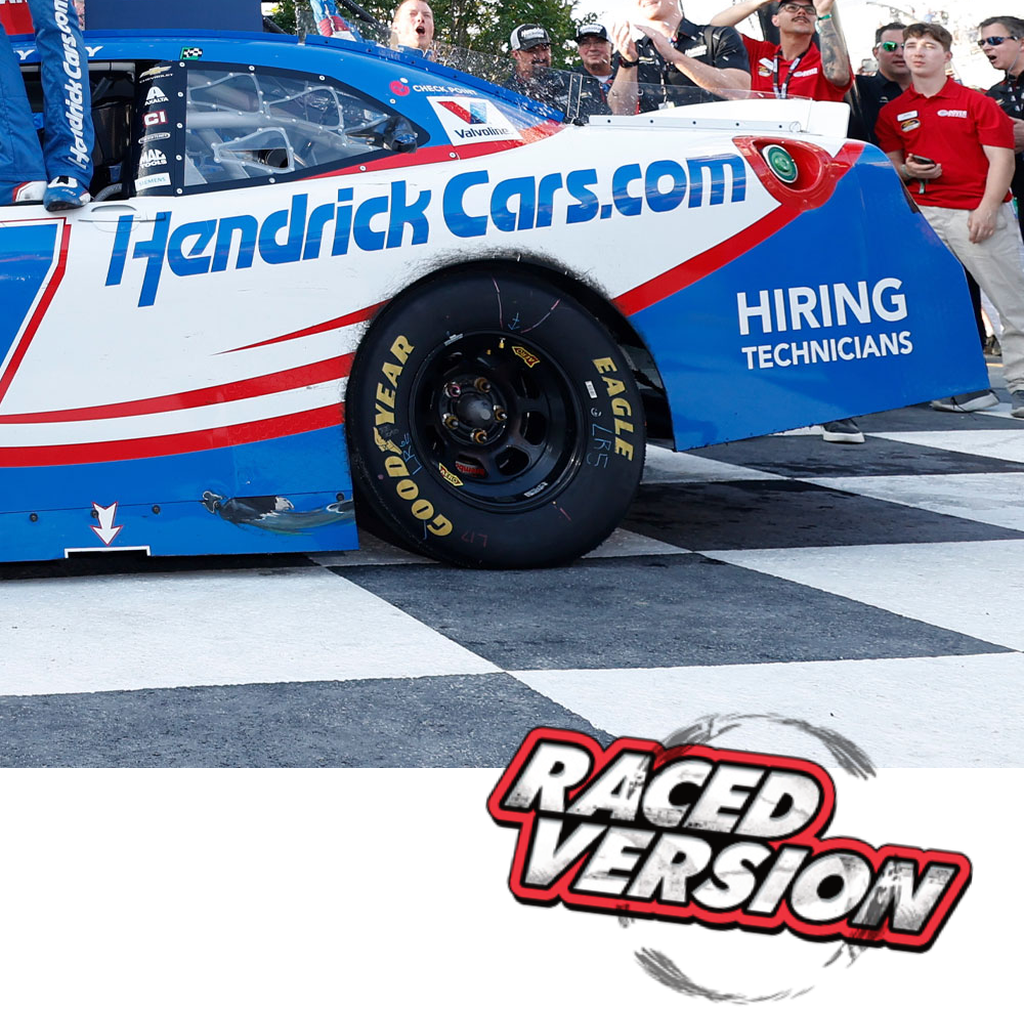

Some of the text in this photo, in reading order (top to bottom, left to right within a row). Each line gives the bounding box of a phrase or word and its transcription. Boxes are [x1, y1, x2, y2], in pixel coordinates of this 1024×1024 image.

[144, 96, 170, 107] AXALTA
[412, 84, 478, 95] CHECK POINT
[143, 111, 166, 125] CI
[454, 126, 510, 139] Valvoline
[140, 159, 168, 168] TOOLS
[104, 152, 747, 309] Hendrick Cars.com
[736, 277, 908, 336] HIRING
[741, 330, 914, 370] TECHNICIANS
[591, 356, 635, 462] EAGLE
[372, 334, 453, 537] GOODYEAR
